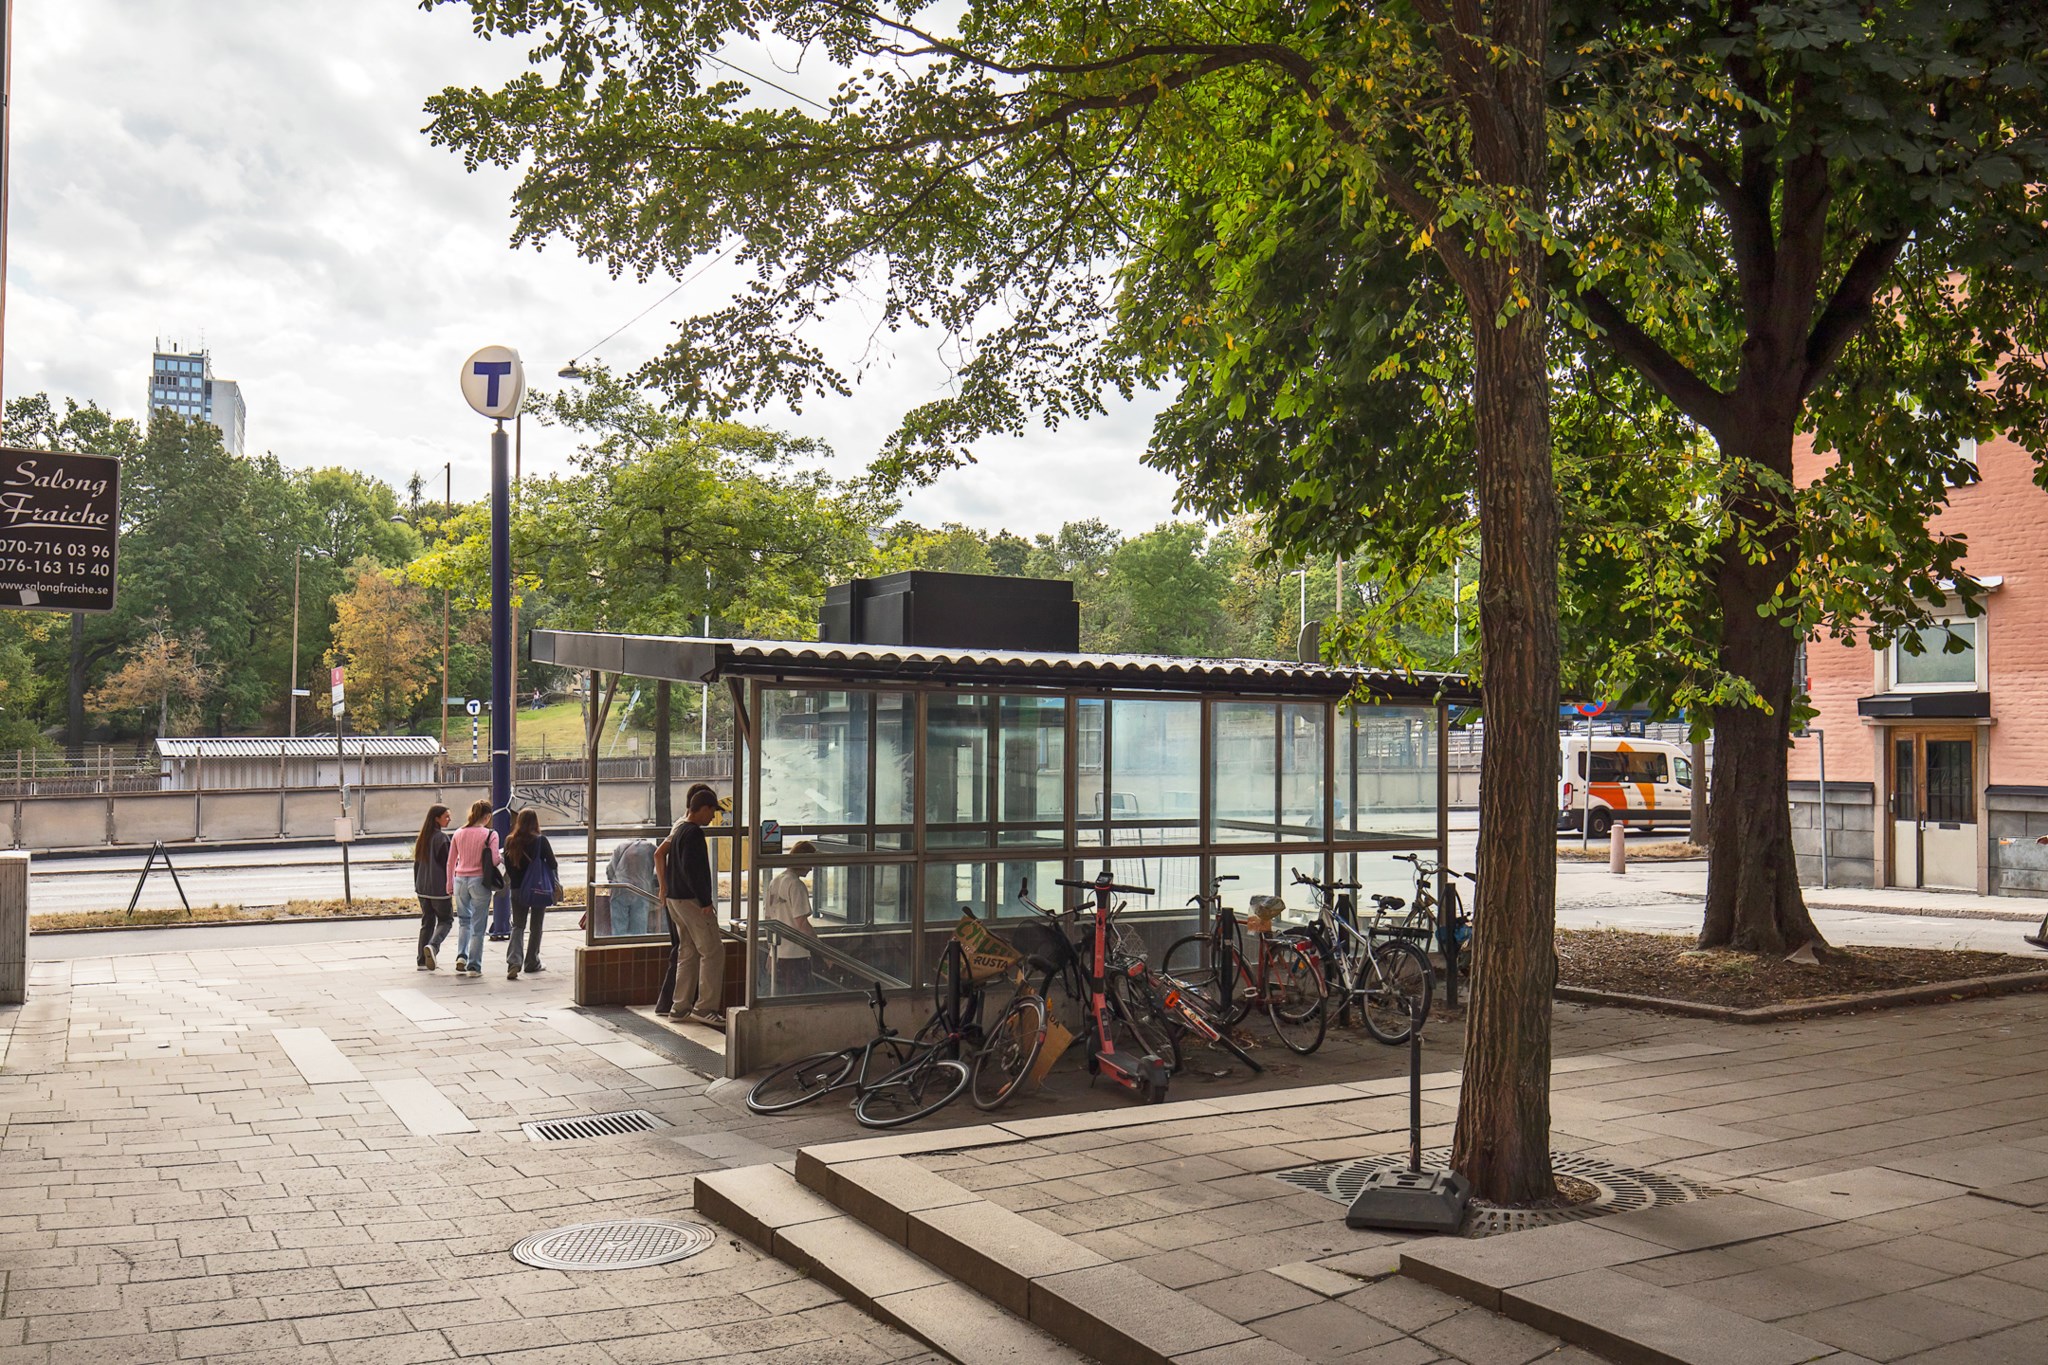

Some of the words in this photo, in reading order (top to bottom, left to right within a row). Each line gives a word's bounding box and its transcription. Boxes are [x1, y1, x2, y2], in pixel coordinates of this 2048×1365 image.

[473, 361, 511, 407] T
[3, 460, 108, 498] Salong
[0, 492, 109, 526] Fraiche
[0, 539, 62, 556] 070-716
[67, 543, 86, 557] 03
[91, 545, 110, 558] 96
[0, 558, 62, 574] 076-163
[68, 562, 86, 575] 15
[90, 563, 110, 577] 40
[469, 703, 478, 713] T
[974, 956, 1009, 970] RUSTA
